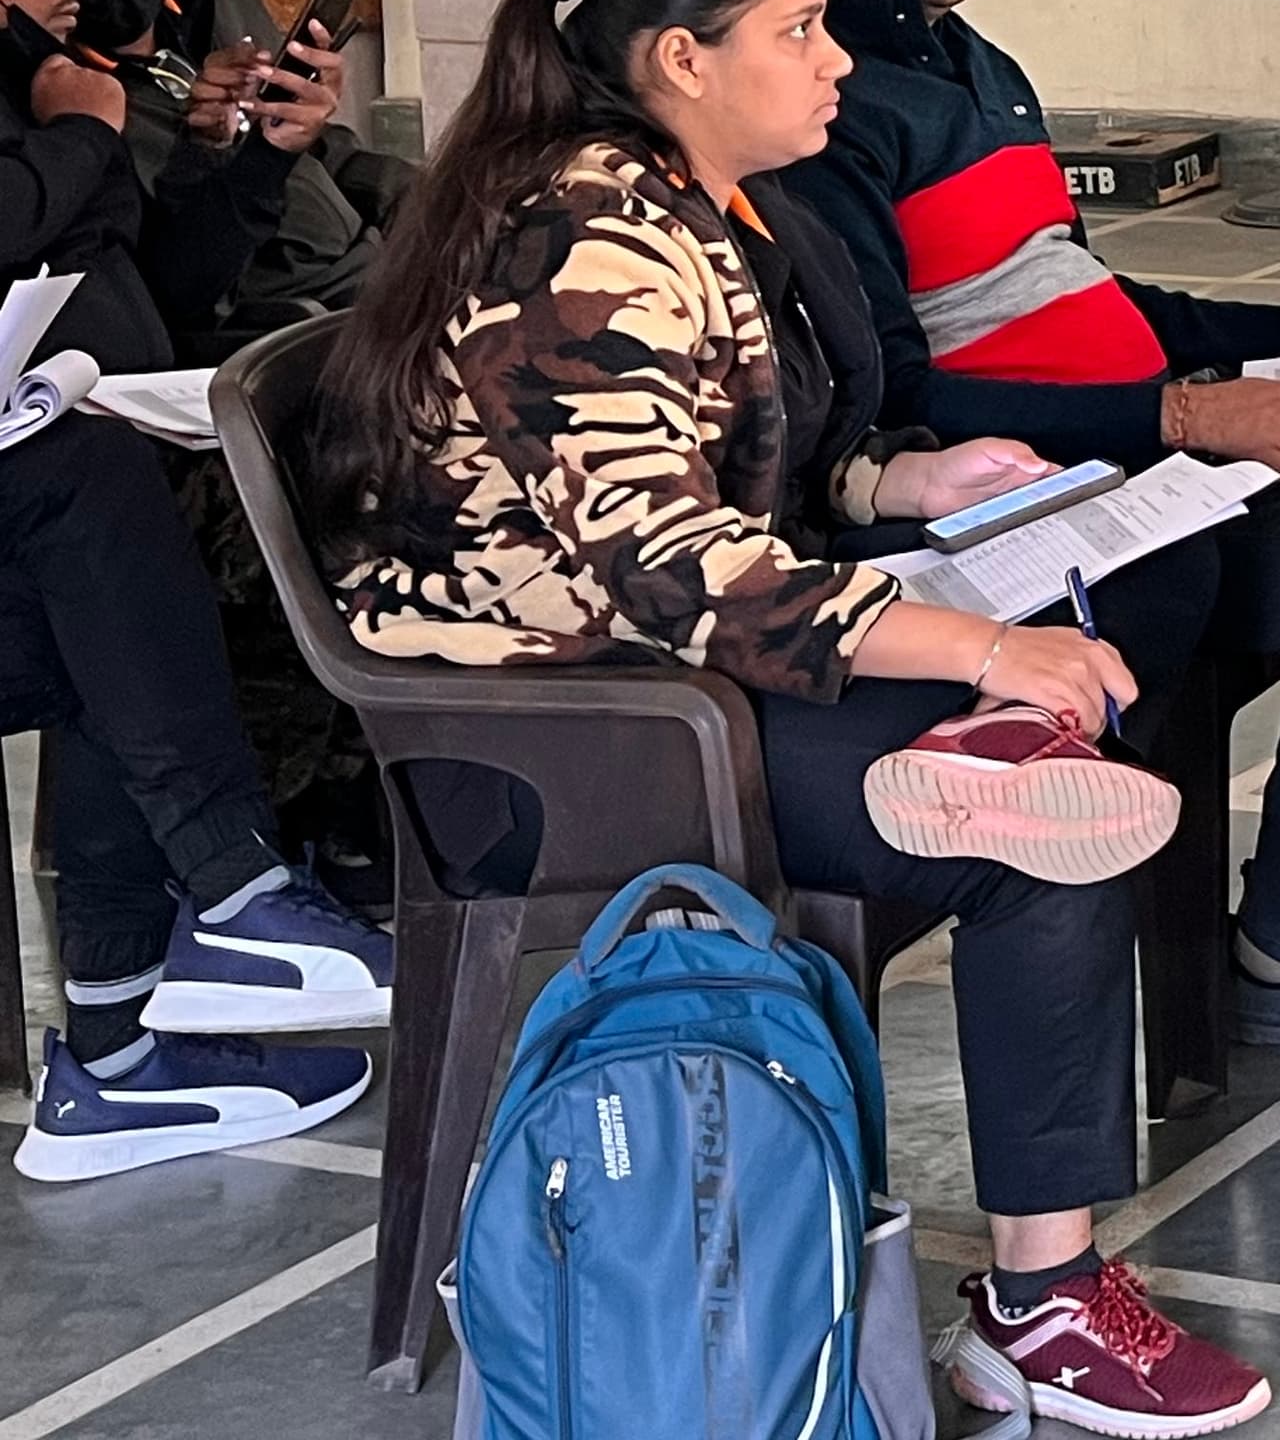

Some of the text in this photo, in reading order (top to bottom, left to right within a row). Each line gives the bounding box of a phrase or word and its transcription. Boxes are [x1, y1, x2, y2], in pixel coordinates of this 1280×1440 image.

[1064, 166, 1116, 195] ETB
[1174, 153, 1200, 187] ETB
[596, 1097, 620, 1180] AMERICAN
[609, 1094, 632, 1178] TOURISTER
